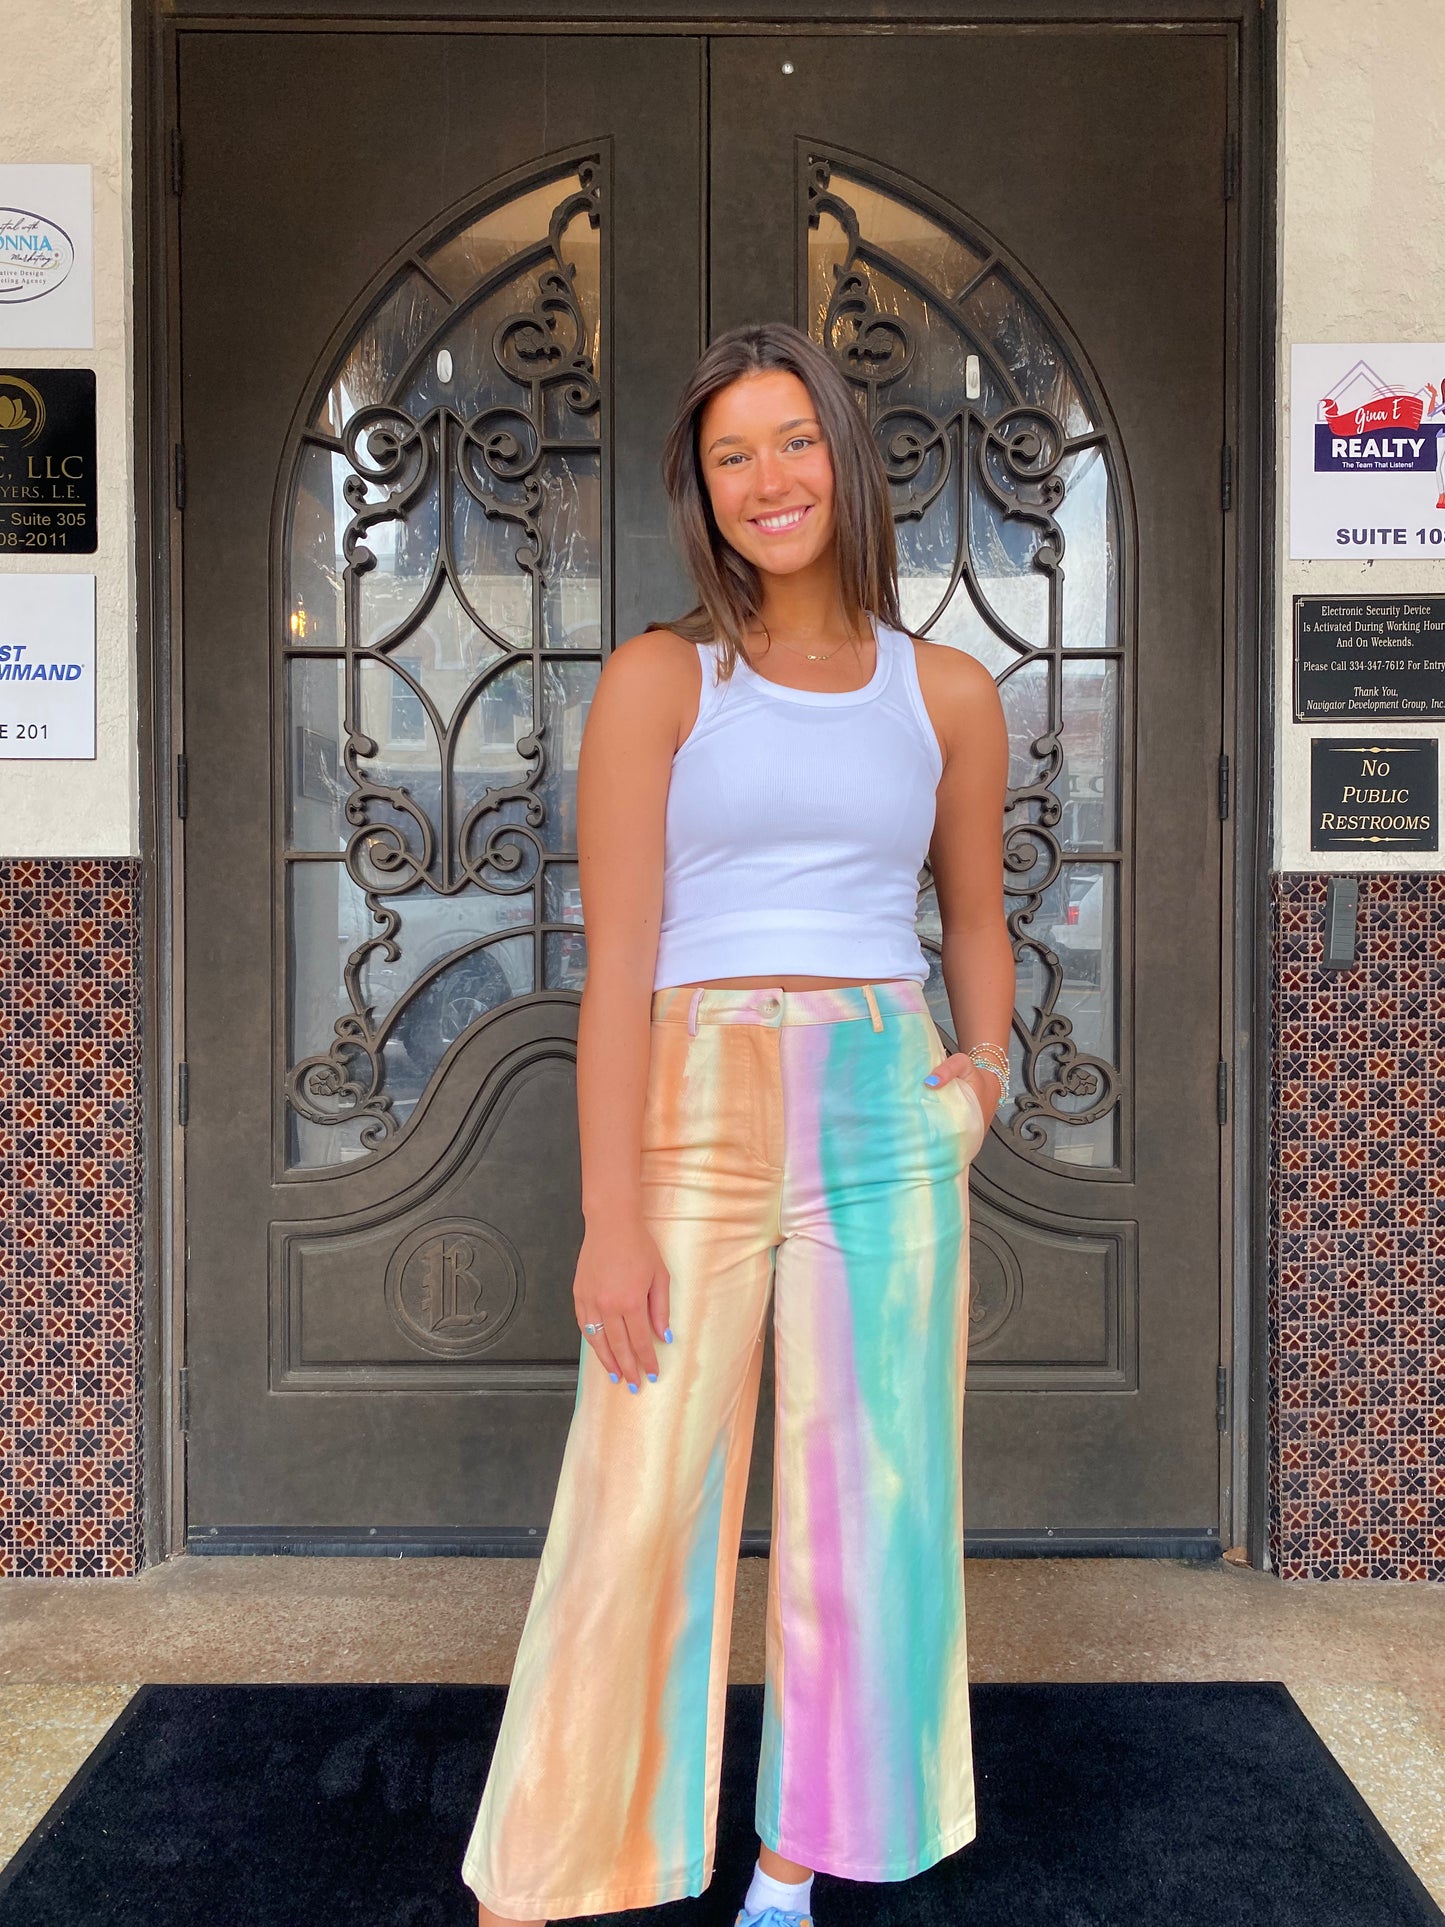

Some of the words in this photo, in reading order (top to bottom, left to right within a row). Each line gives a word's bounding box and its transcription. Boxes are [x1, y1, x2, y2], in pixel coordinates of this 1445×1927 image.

[1331, 438, 1426, 458] REALTY
[27, 455, 84, 480] LLC
[52, 484, 80, 498] L.E.
[11, 512, 51, 526] Suite
[56, 512, 87, 526] 305
[1336, 528, 1407, 545] SUITE
[1415, 528, 1445, 545] 10
[1321, 605, 1363, 616] Electronic
[1366, 605, 1400, 617] Security
[1403, 604, 1431, 615] Device
[1303, 622, 1311, 632] Is
[1313, 621, 1352, 632] Activated
[1354, 621, 1384, 634] During
[1386, 620, 1421, 633] Working
[1336, 637, 1353, 648] And
[1356, 637, 1368, 647] On
[1371, 636, 1414, 647] Weekends.
[1303, 661, 1329, 671] Please
[1330, 661, 1347, 671] Call
[1349, 660, 1405, 671] 334-347-7612
[1407, 660, 1421, 670] For
[1353, 686, 1379, 697] Thank
[1306, 700, 1346, 712] Navigator
[1348, 699, 1399, 711] Development
[1402, 698, 1428, 711] Group,
[16, 724, 47, 739] 201
